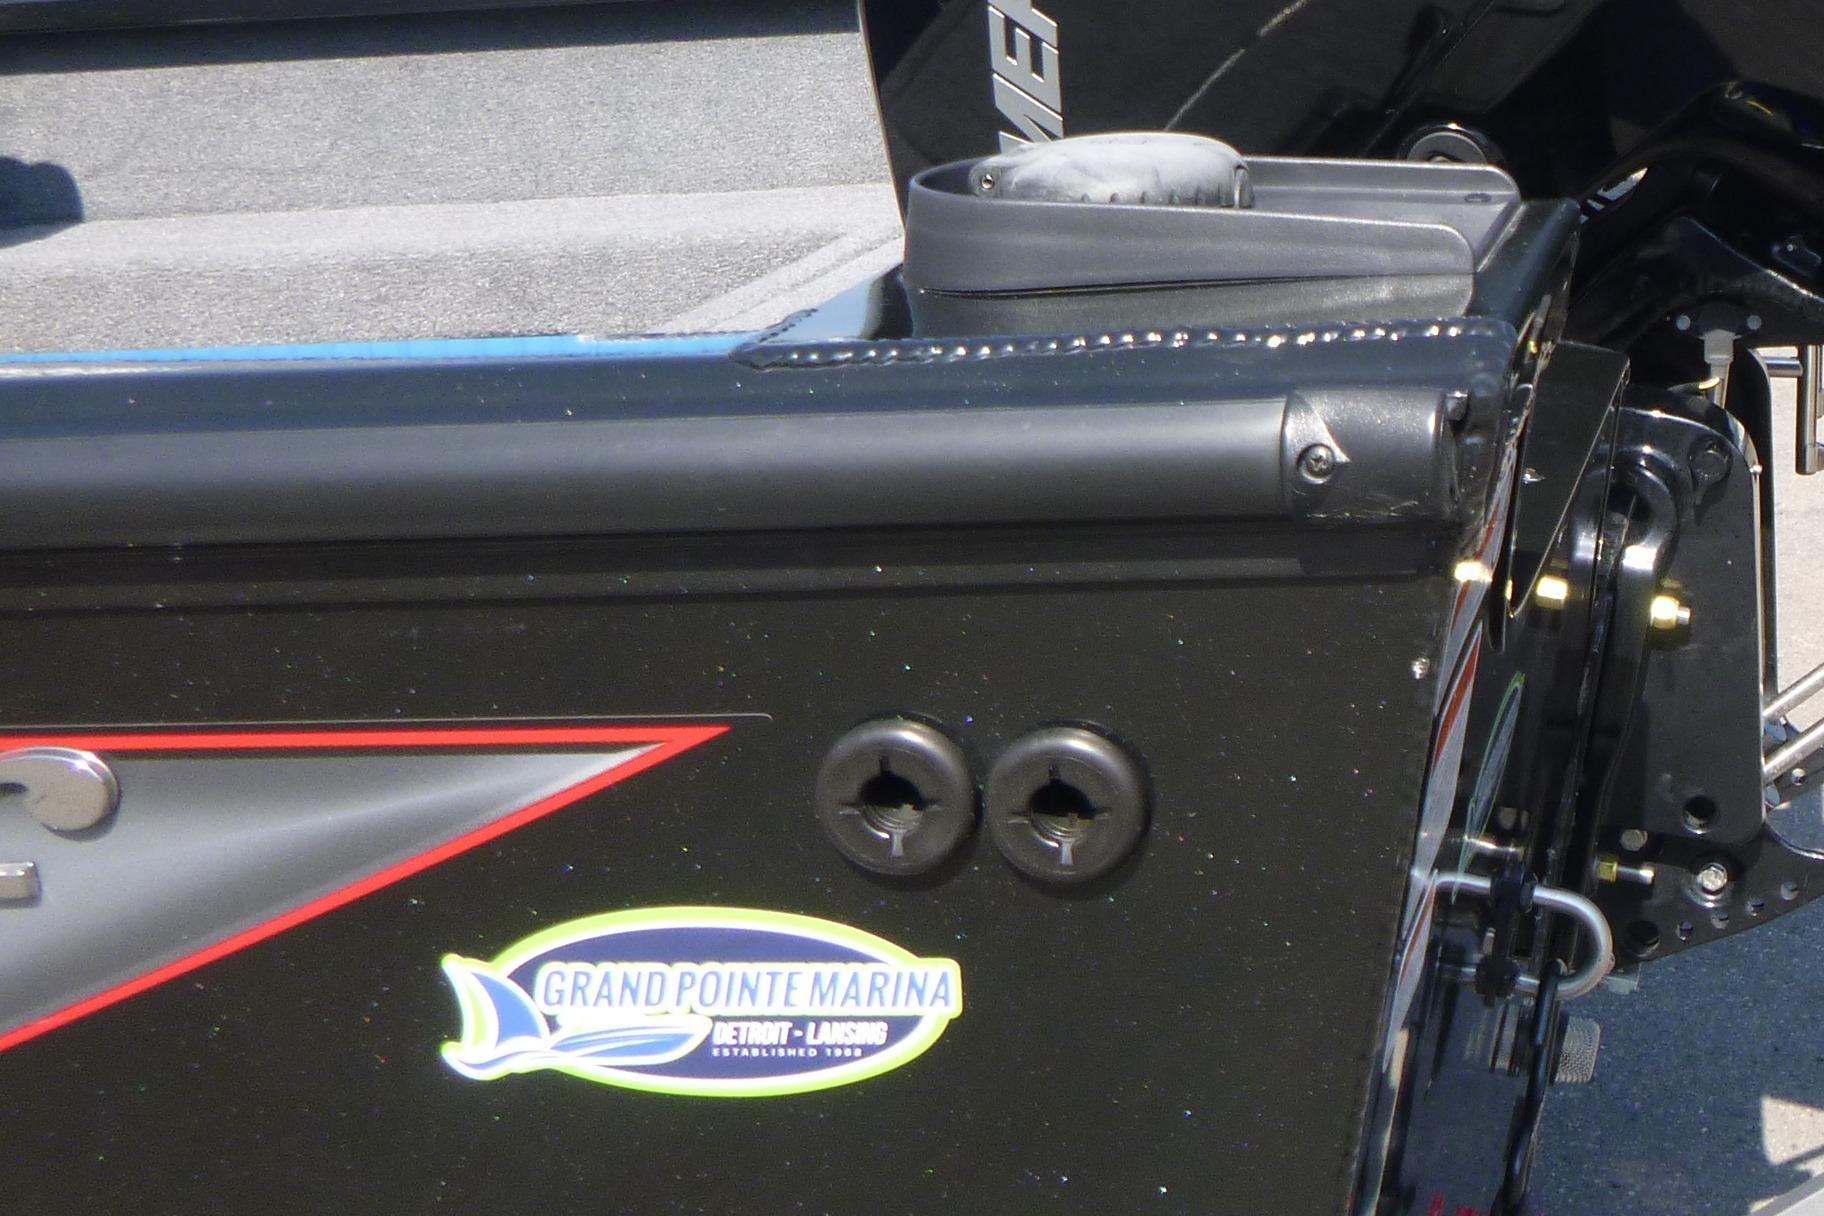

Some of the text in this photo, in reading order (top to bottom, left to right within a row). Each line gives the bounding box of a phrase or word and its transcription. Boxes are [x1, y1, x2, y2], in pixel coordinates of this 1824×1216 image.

[543, 970, 952, 1008] GRAND POINTE MARINA
[712, 1020, 793, 1045] DETROIT
[805, 1020, 889, 1046] LANSING
[712, 1047, 818, 1058] ESTABLISHED
